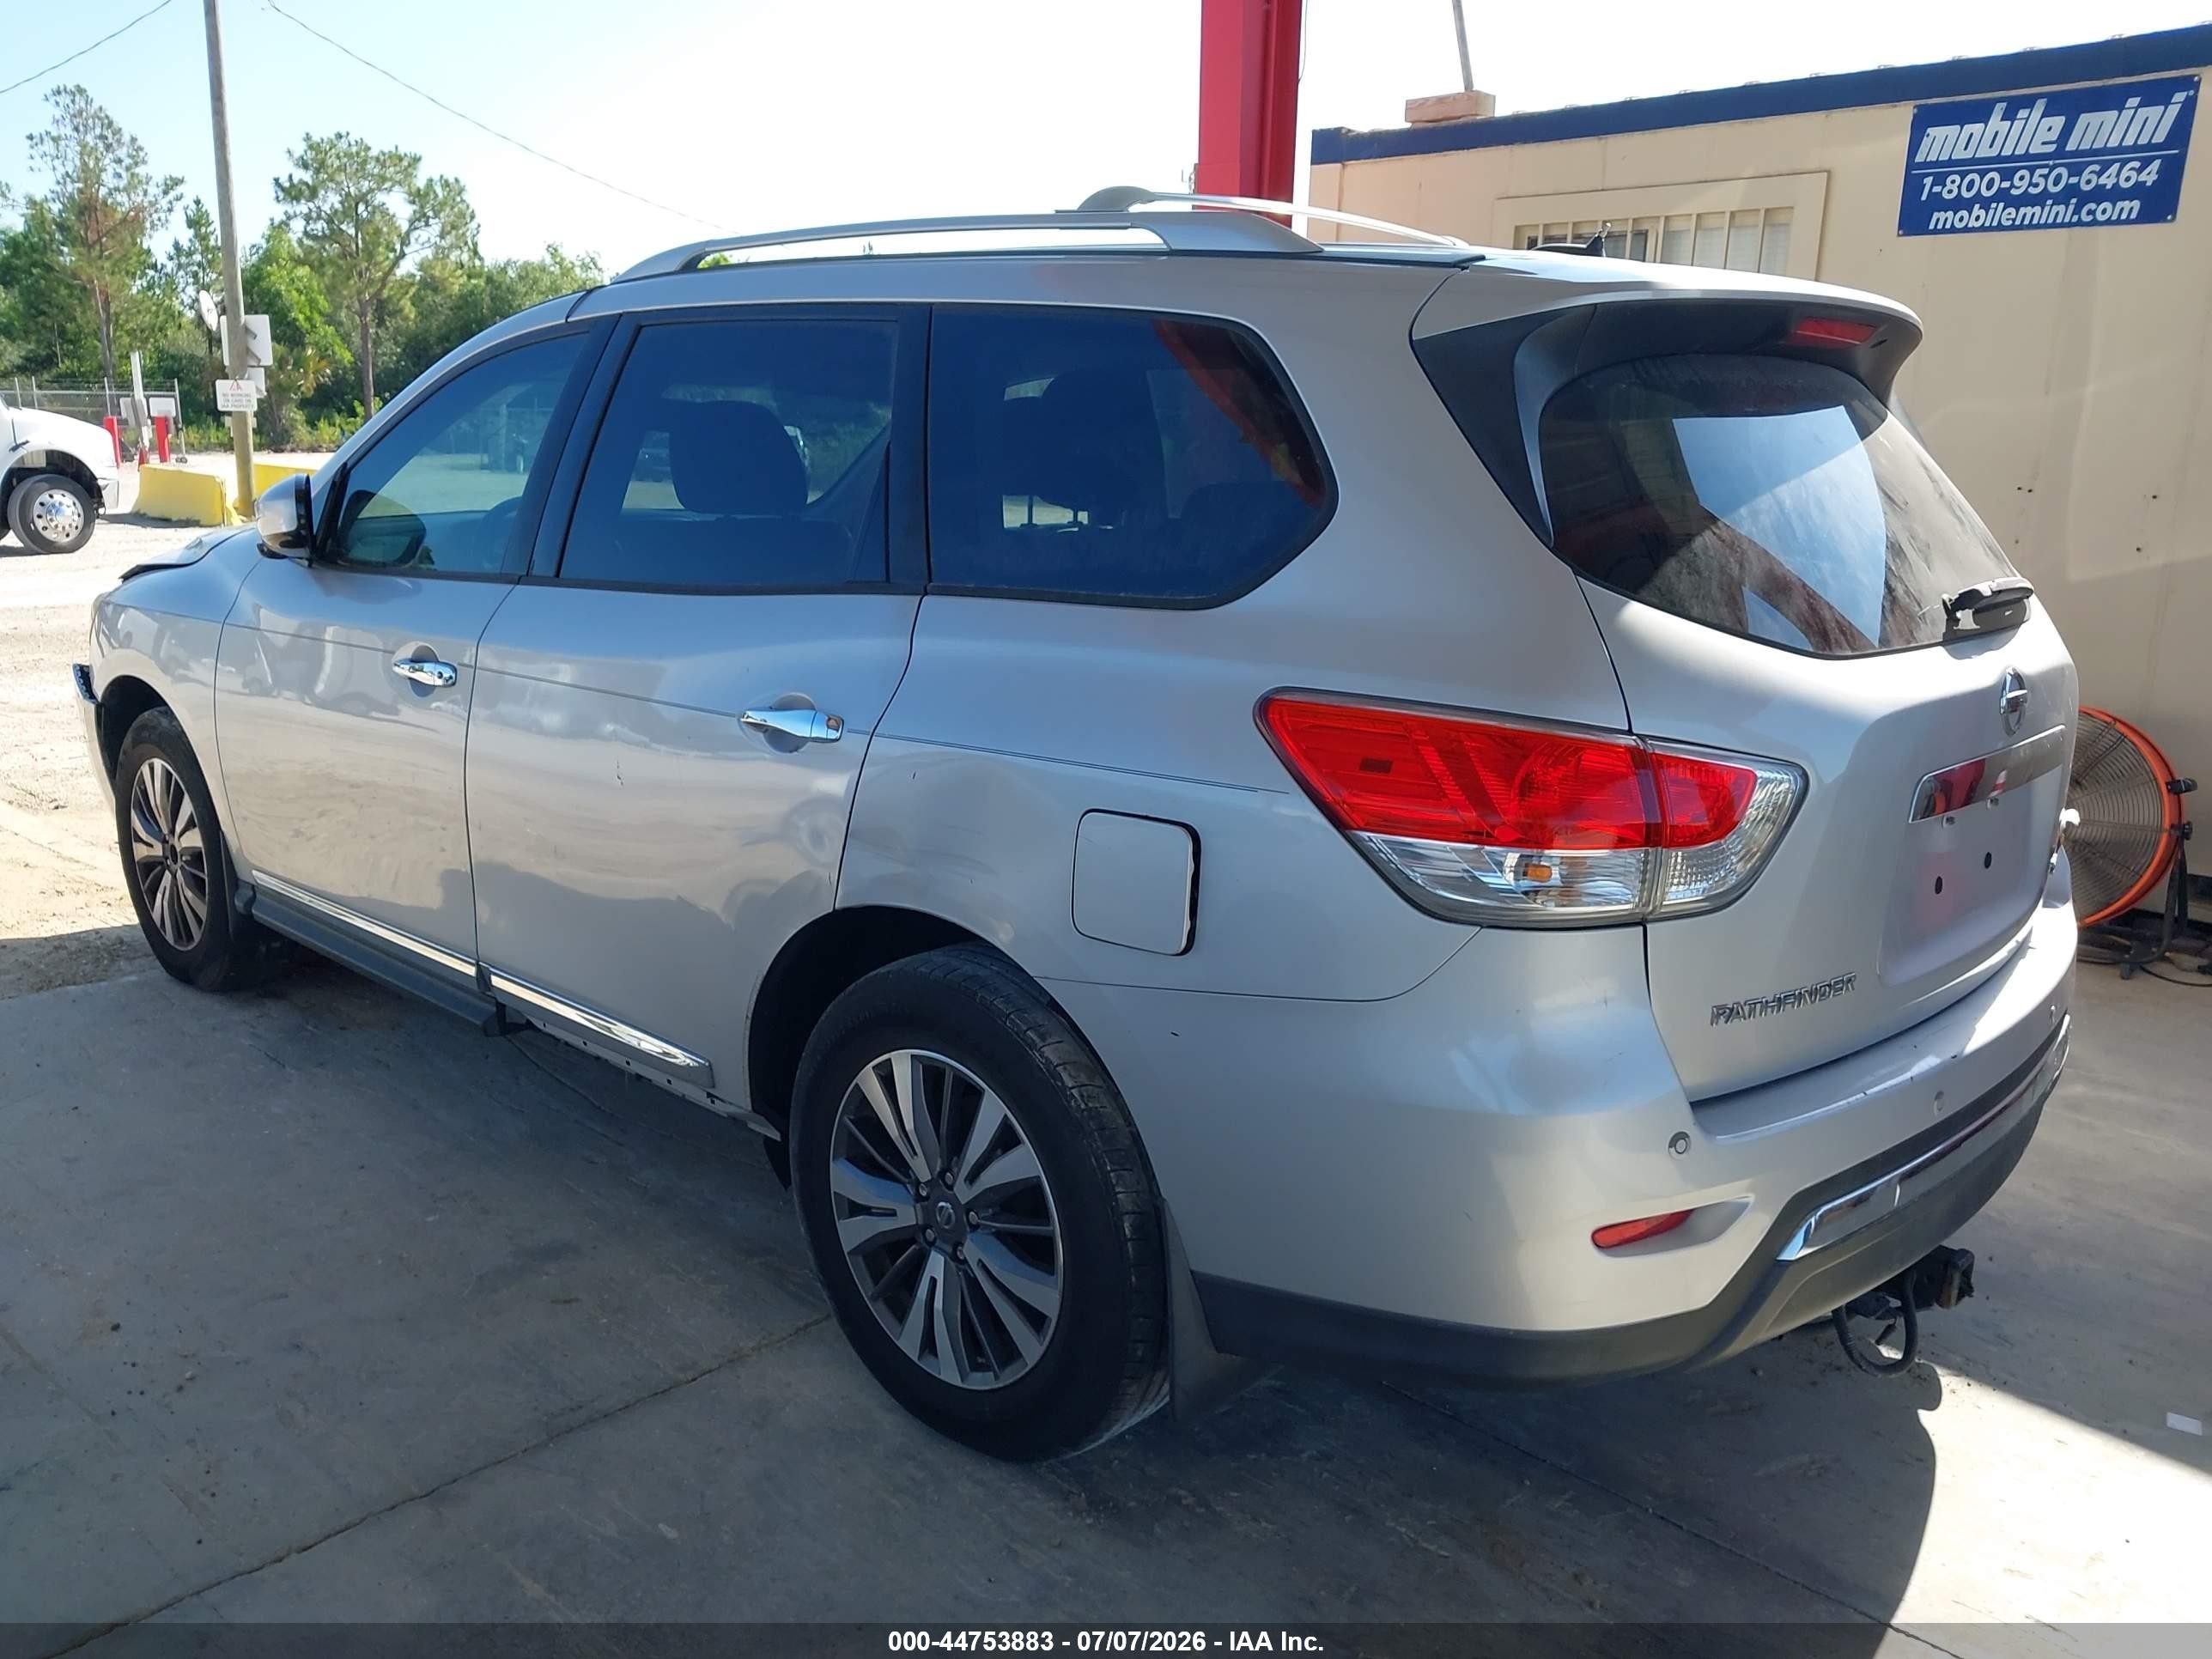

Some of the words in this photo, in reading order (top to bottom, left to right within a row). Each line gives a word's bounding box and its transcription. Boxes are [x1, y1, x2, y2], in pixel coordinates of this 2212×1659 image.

[1914, 98, 2066, 163] mobile
[2065, 91, 2189, 152] mini
[1920, 158, 2162, 202] 1-800-950-6464
[1928, 198, 2141, 231] mobilemini.com
[1710, 971, 1856, 1027] PATHFINDER
